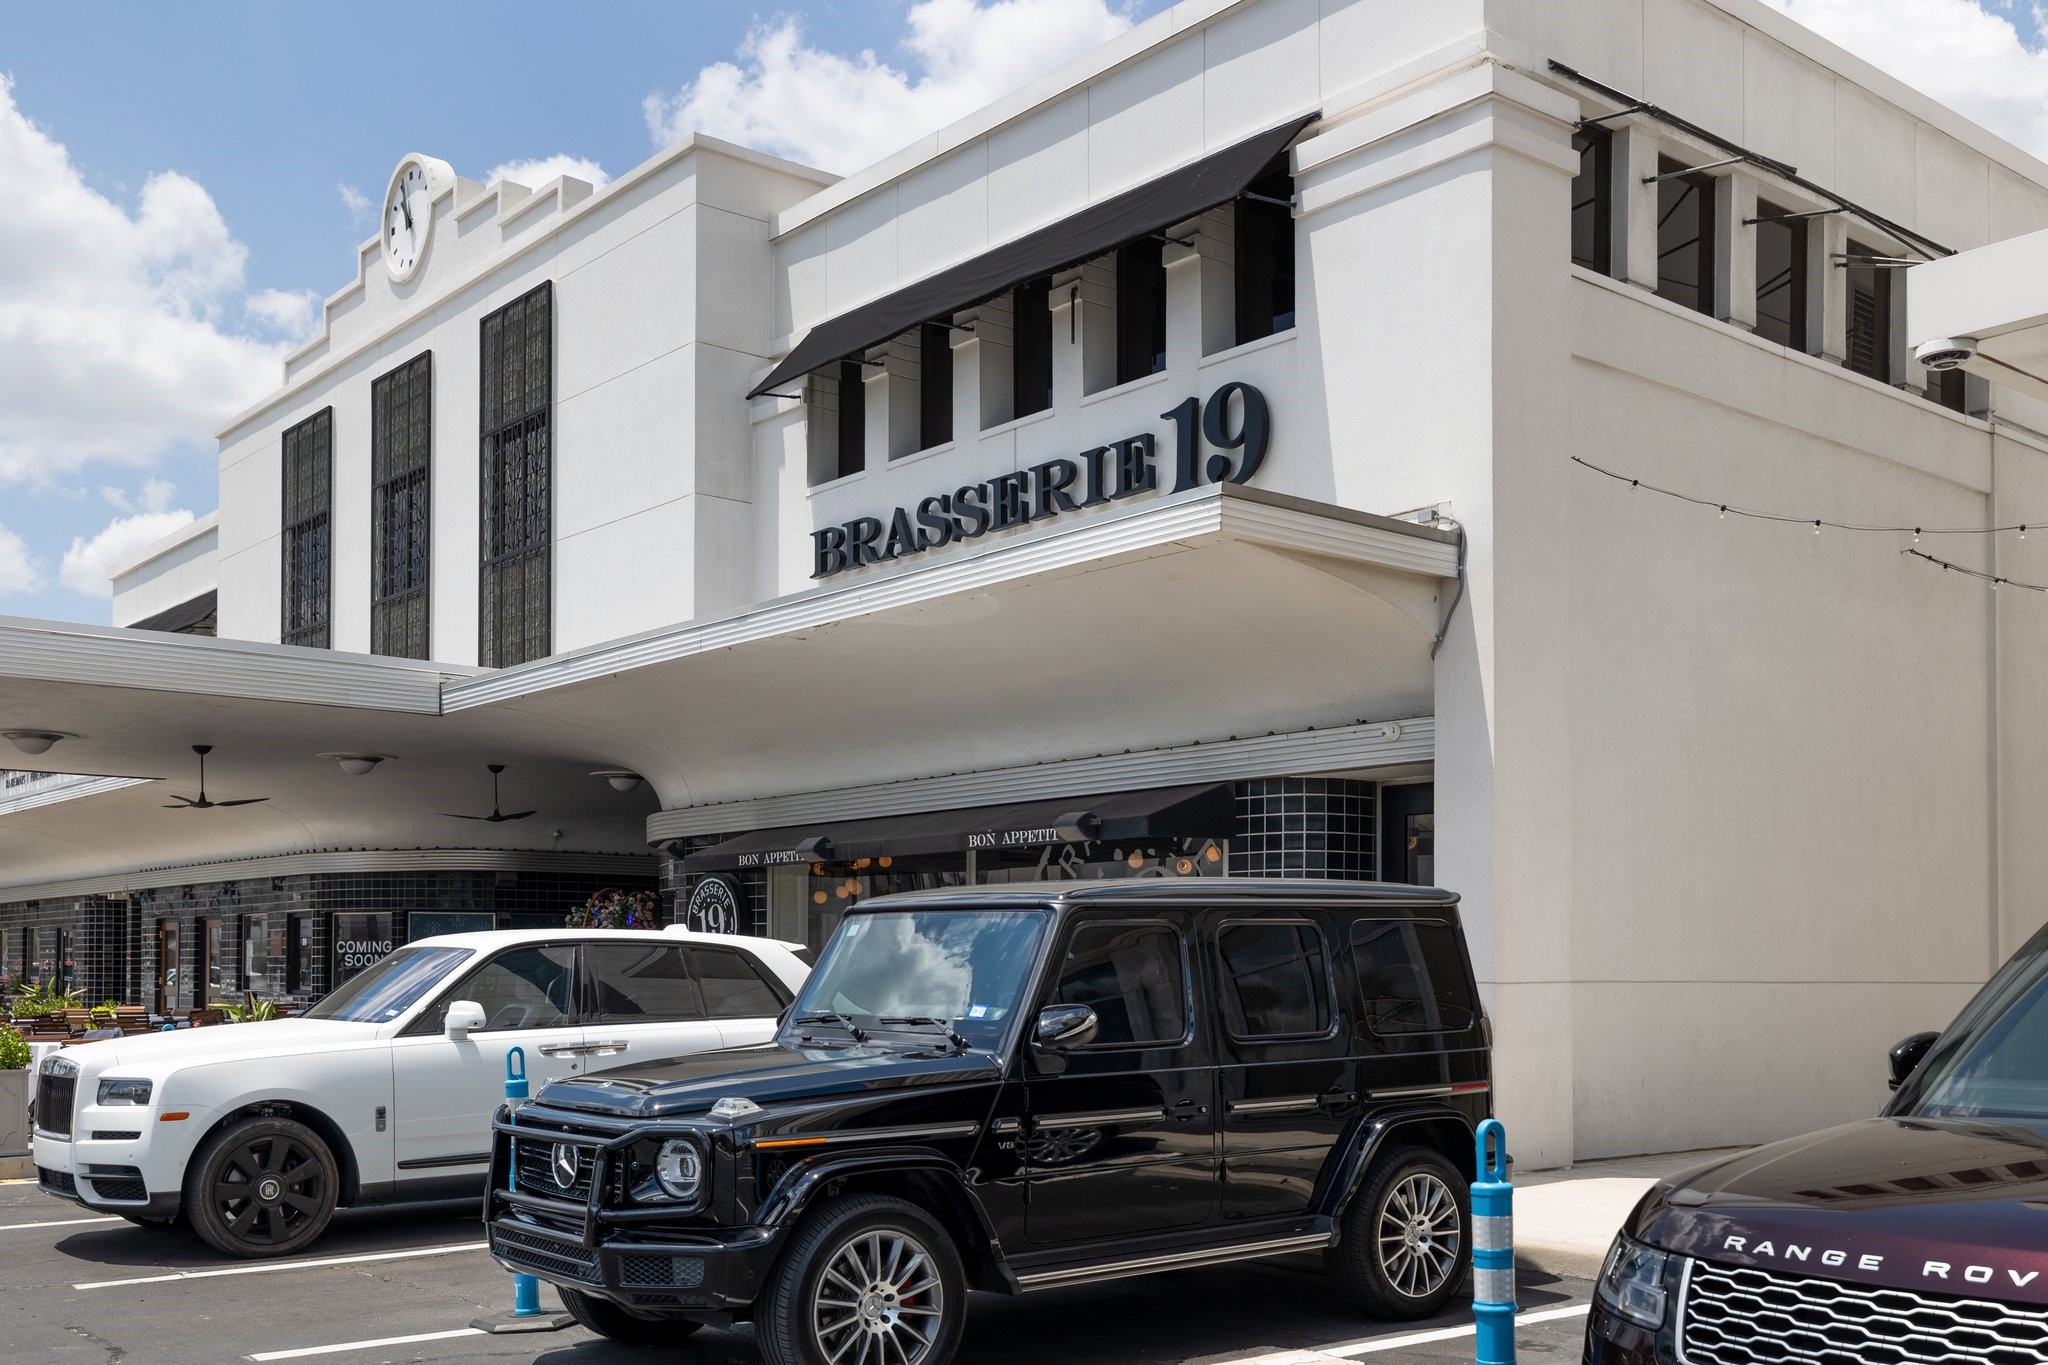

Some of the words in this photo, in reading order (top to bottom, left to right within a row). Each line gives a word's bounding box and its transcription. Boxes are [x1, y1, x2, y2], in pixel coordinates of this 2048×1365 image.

[810, 432, 1156, 579] BRASSERIE
[1160, 381, 1269, 495] 19
[967, 832, 996, 848] BON
[738, 853, 759, 866] BON
[763, 850, 804, 864] APPETI
[692, 883, 731, 914] BRASSERIE
[696, 903, 725, 935] 19
[336, 940, 392, 953] COMING
[998, 1141, 1015, 1150] V8
[1723, 1235, 1884, 1271] RANGE
[1922, 1260, 2039, 1287] ROV
